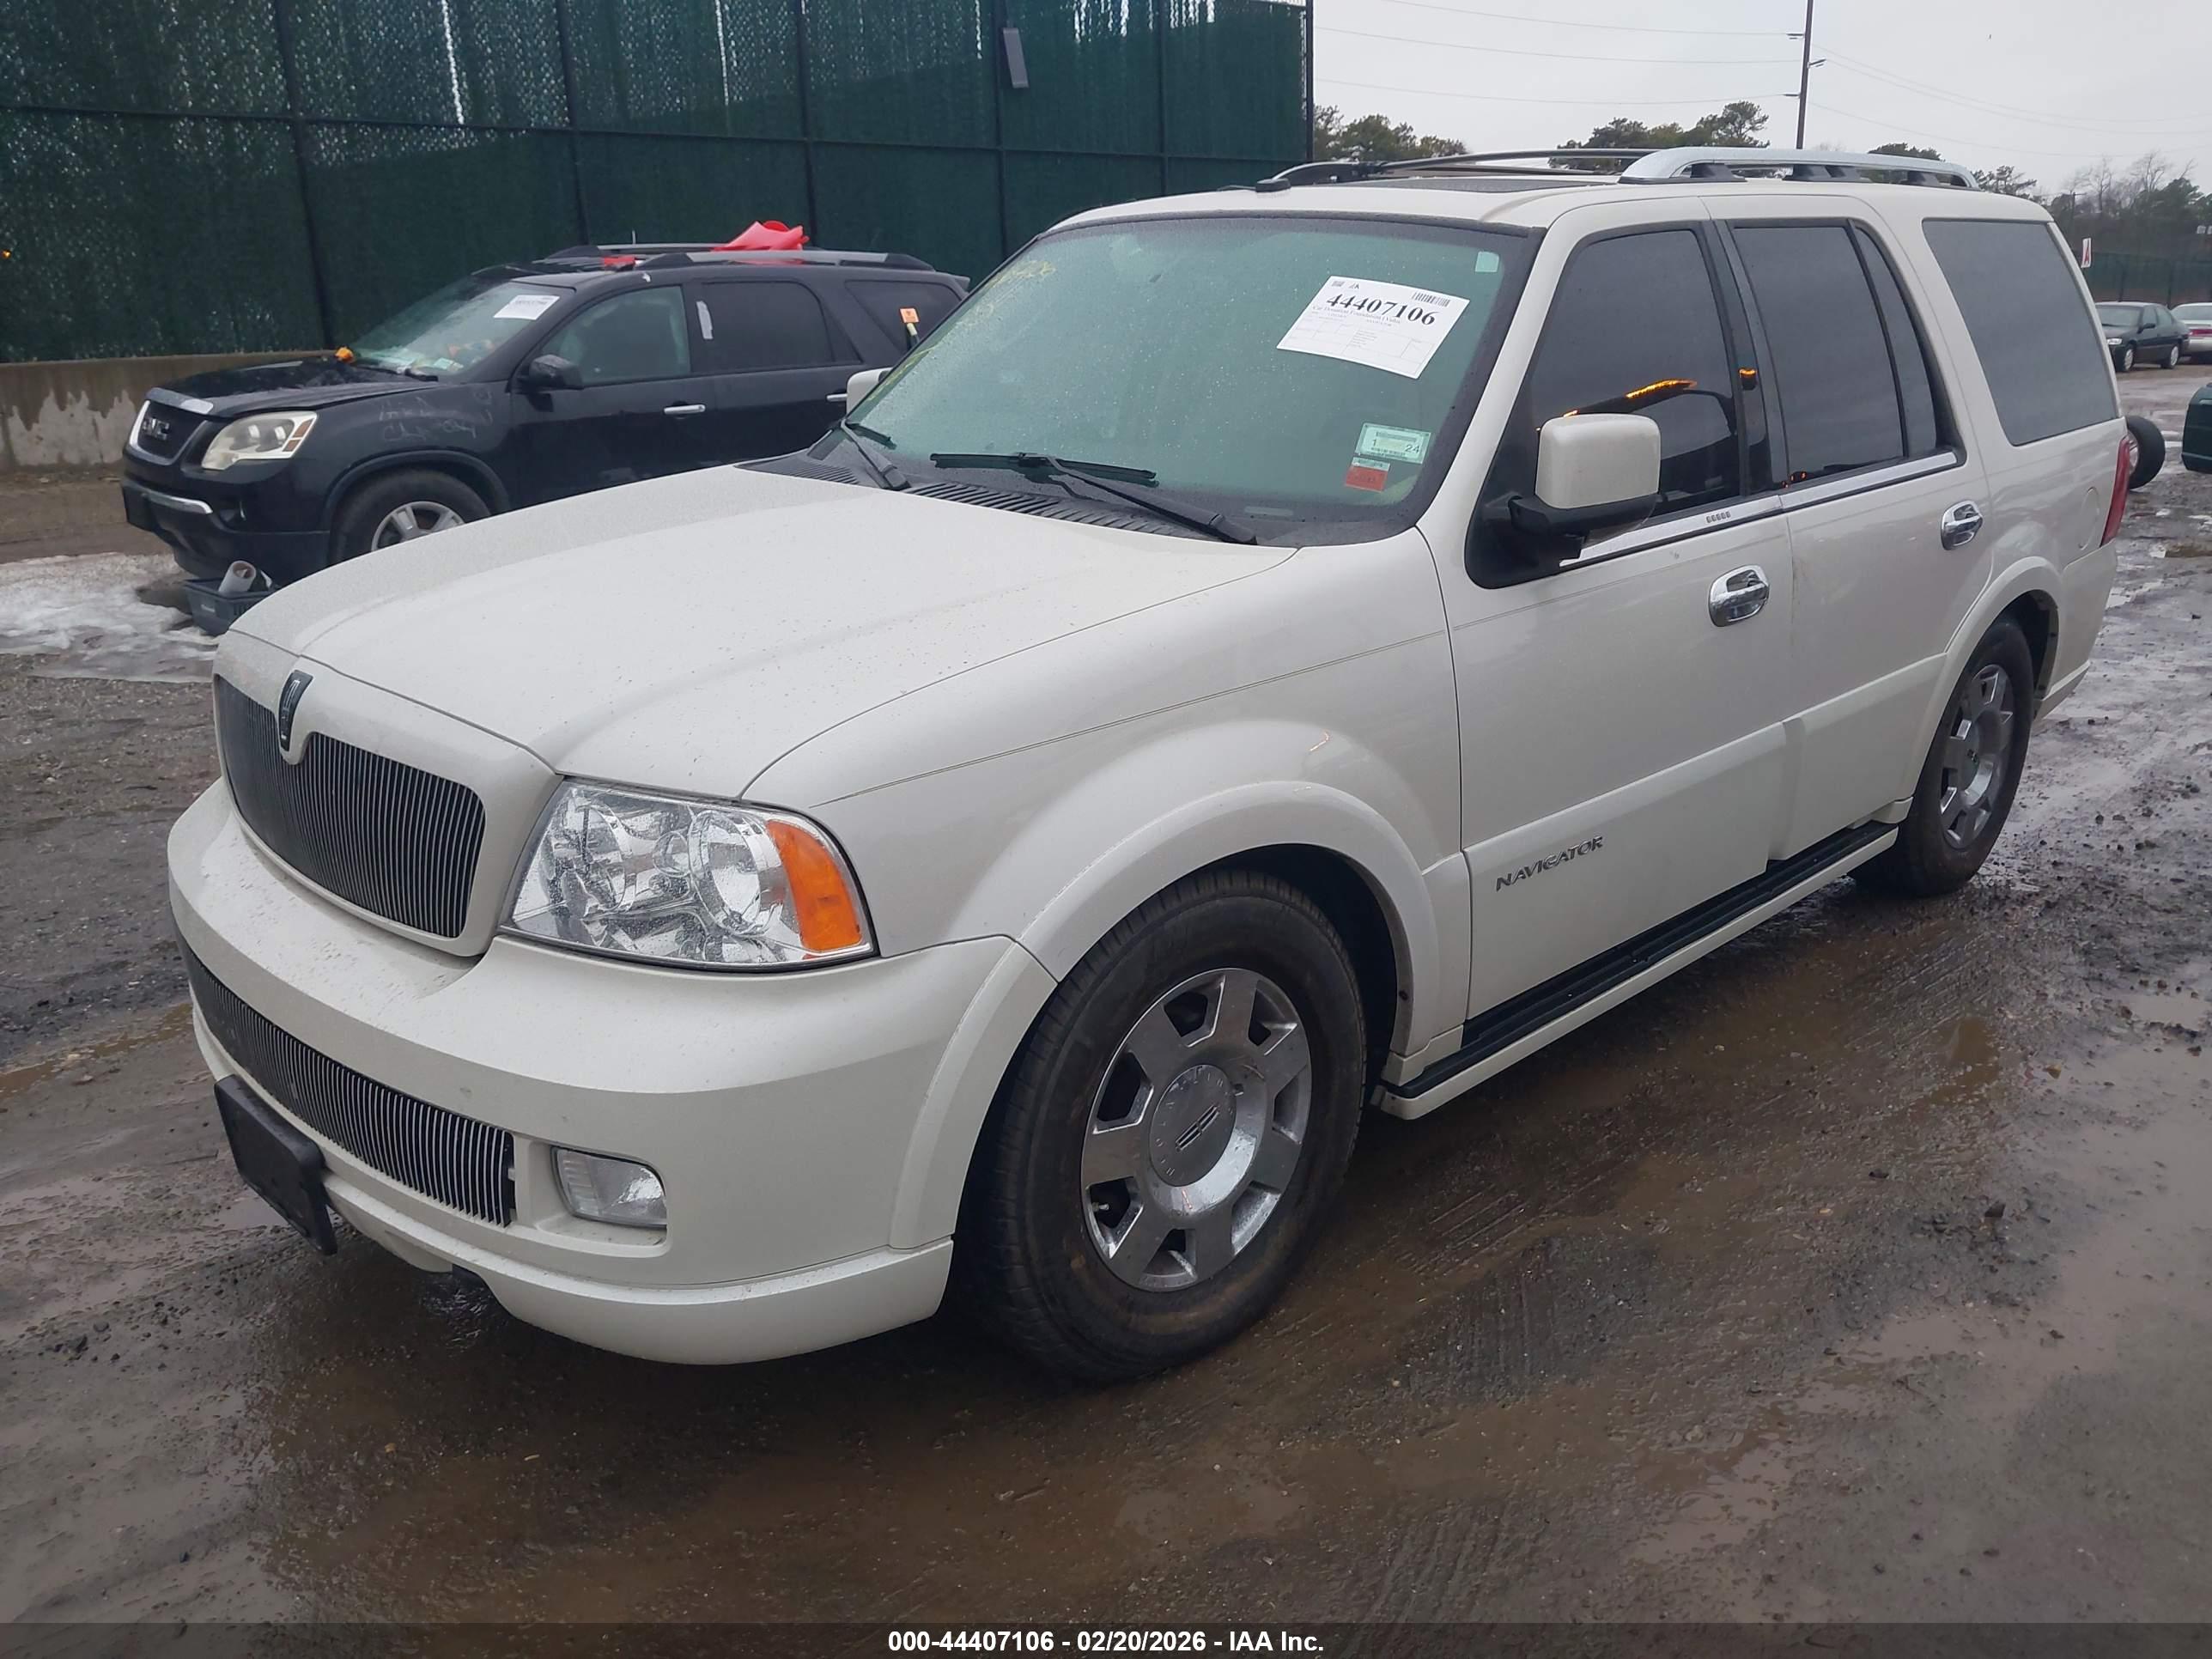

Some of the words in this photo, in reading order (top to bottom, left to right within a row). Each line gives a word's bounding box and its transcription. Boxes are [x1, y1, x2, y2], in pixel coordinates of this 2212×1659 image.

[1327, 293, 1440, 325] 44407106
[1405, 443, 1419, 454] 24
[1496, 836, 1603, 892] NAVIGATOR
